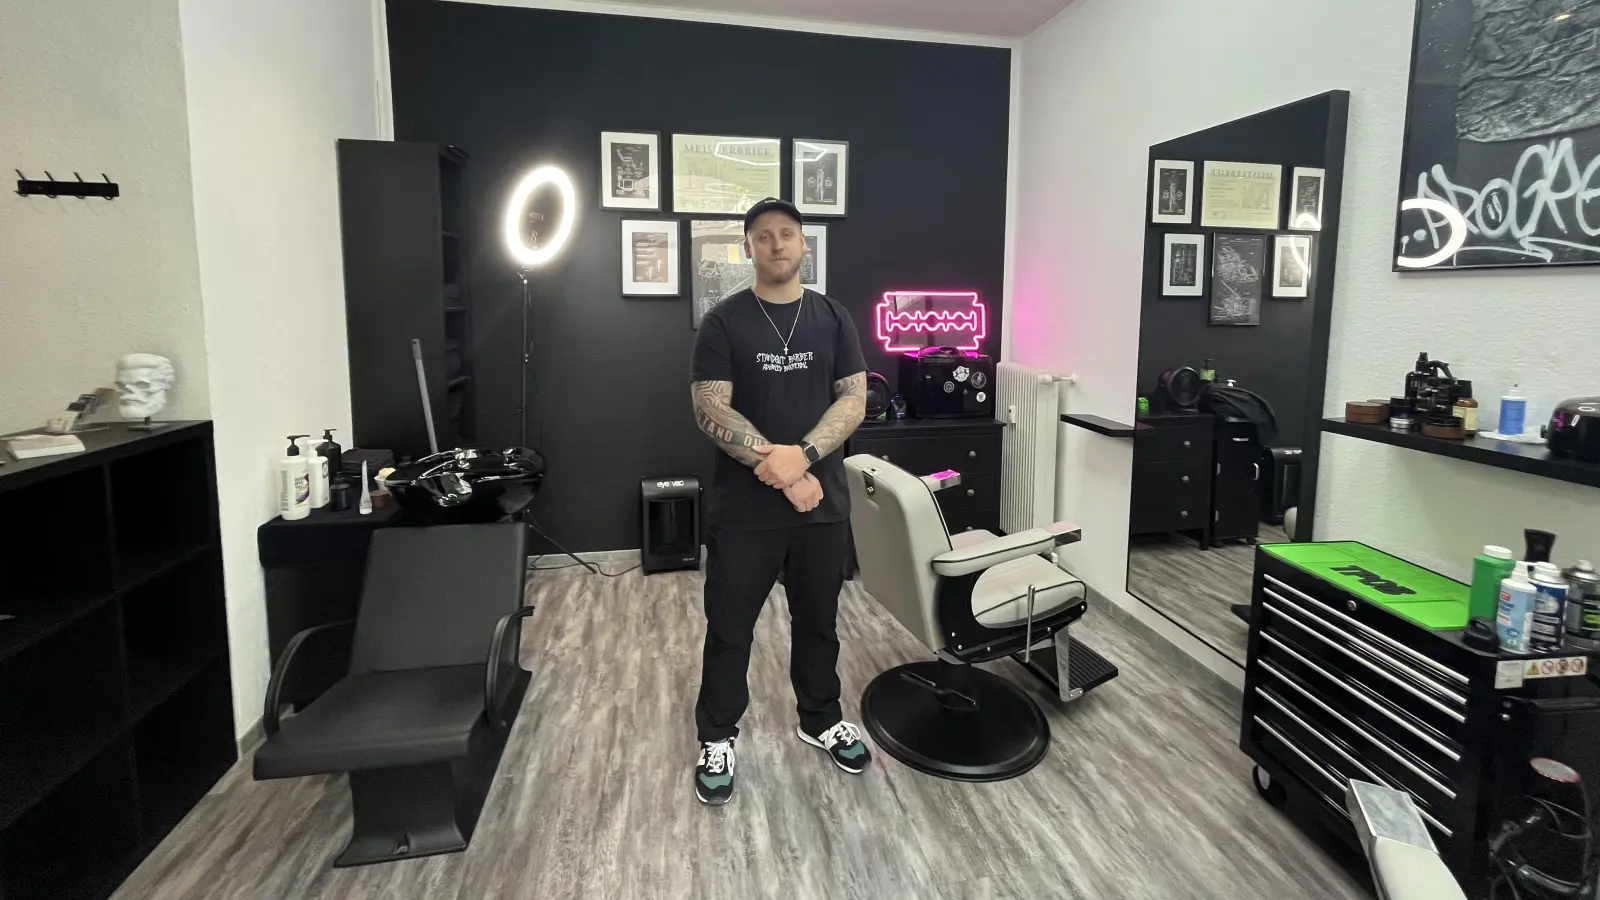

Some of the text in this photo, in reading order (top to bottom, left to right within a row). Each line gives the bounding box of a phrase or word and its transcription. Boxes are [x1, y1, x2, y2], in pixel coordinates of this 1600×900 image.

[684, 144, 771, 156] MEISERBRIEF
[787, 351, 814, 365] BARBER
[697, 409, 733, 442] STAND
[657, 480, 685, 490] eye vac
